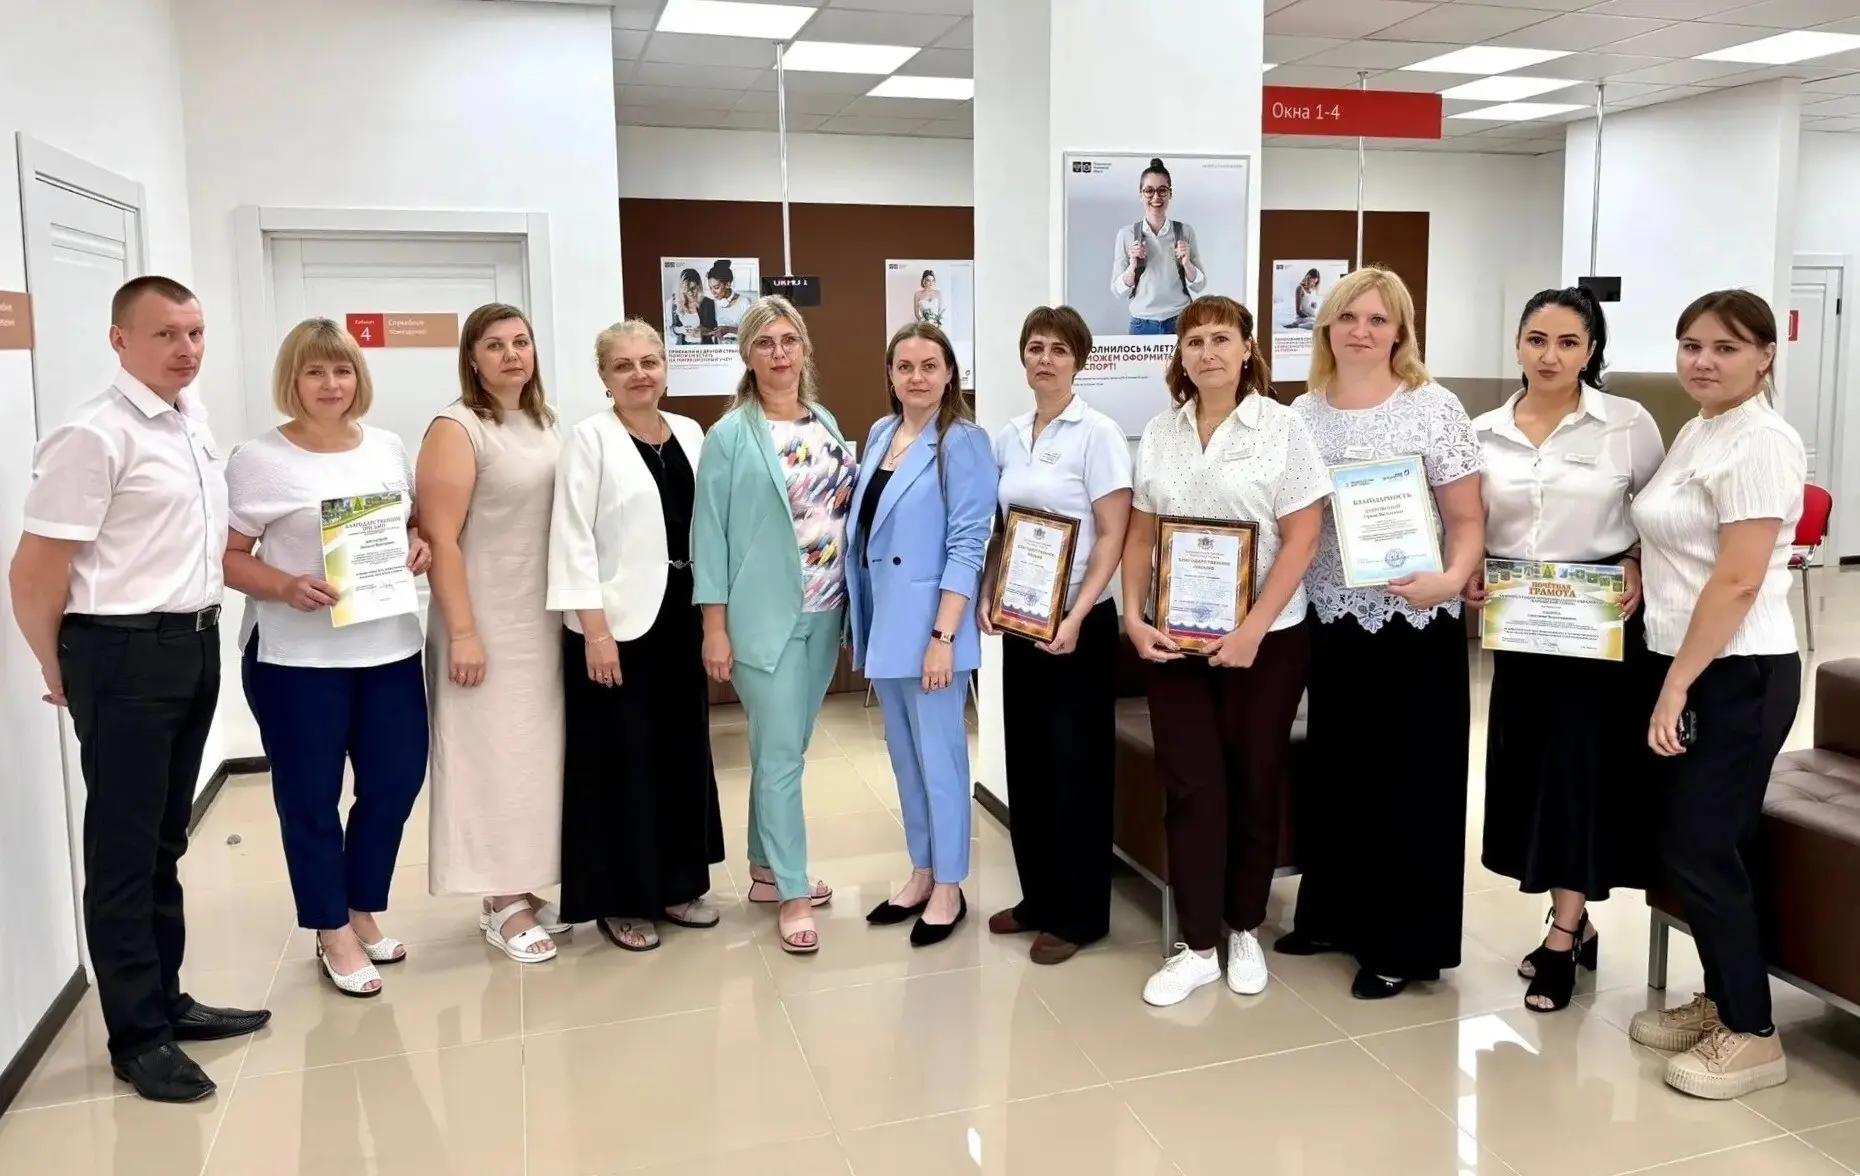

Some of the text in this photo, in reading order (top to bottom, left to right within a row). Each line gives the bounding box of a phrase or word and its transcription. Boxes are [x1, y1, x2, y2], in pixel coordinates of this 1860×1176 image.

[1272, 102, 1341, 120] Окна 1-4
[360, 326, 372, 342] 4
[1090, 345, 1141, 353] ОЛНИЛОСЬ
[1143, 345, 1152, 353] 14
[1084, 362, 1117, 370] СПОРТ!
[1352, 492, 1412, 506] БЛАГОДАРНОСТЬ
[1528, 587, 1577, 598] ГРАМОТА
